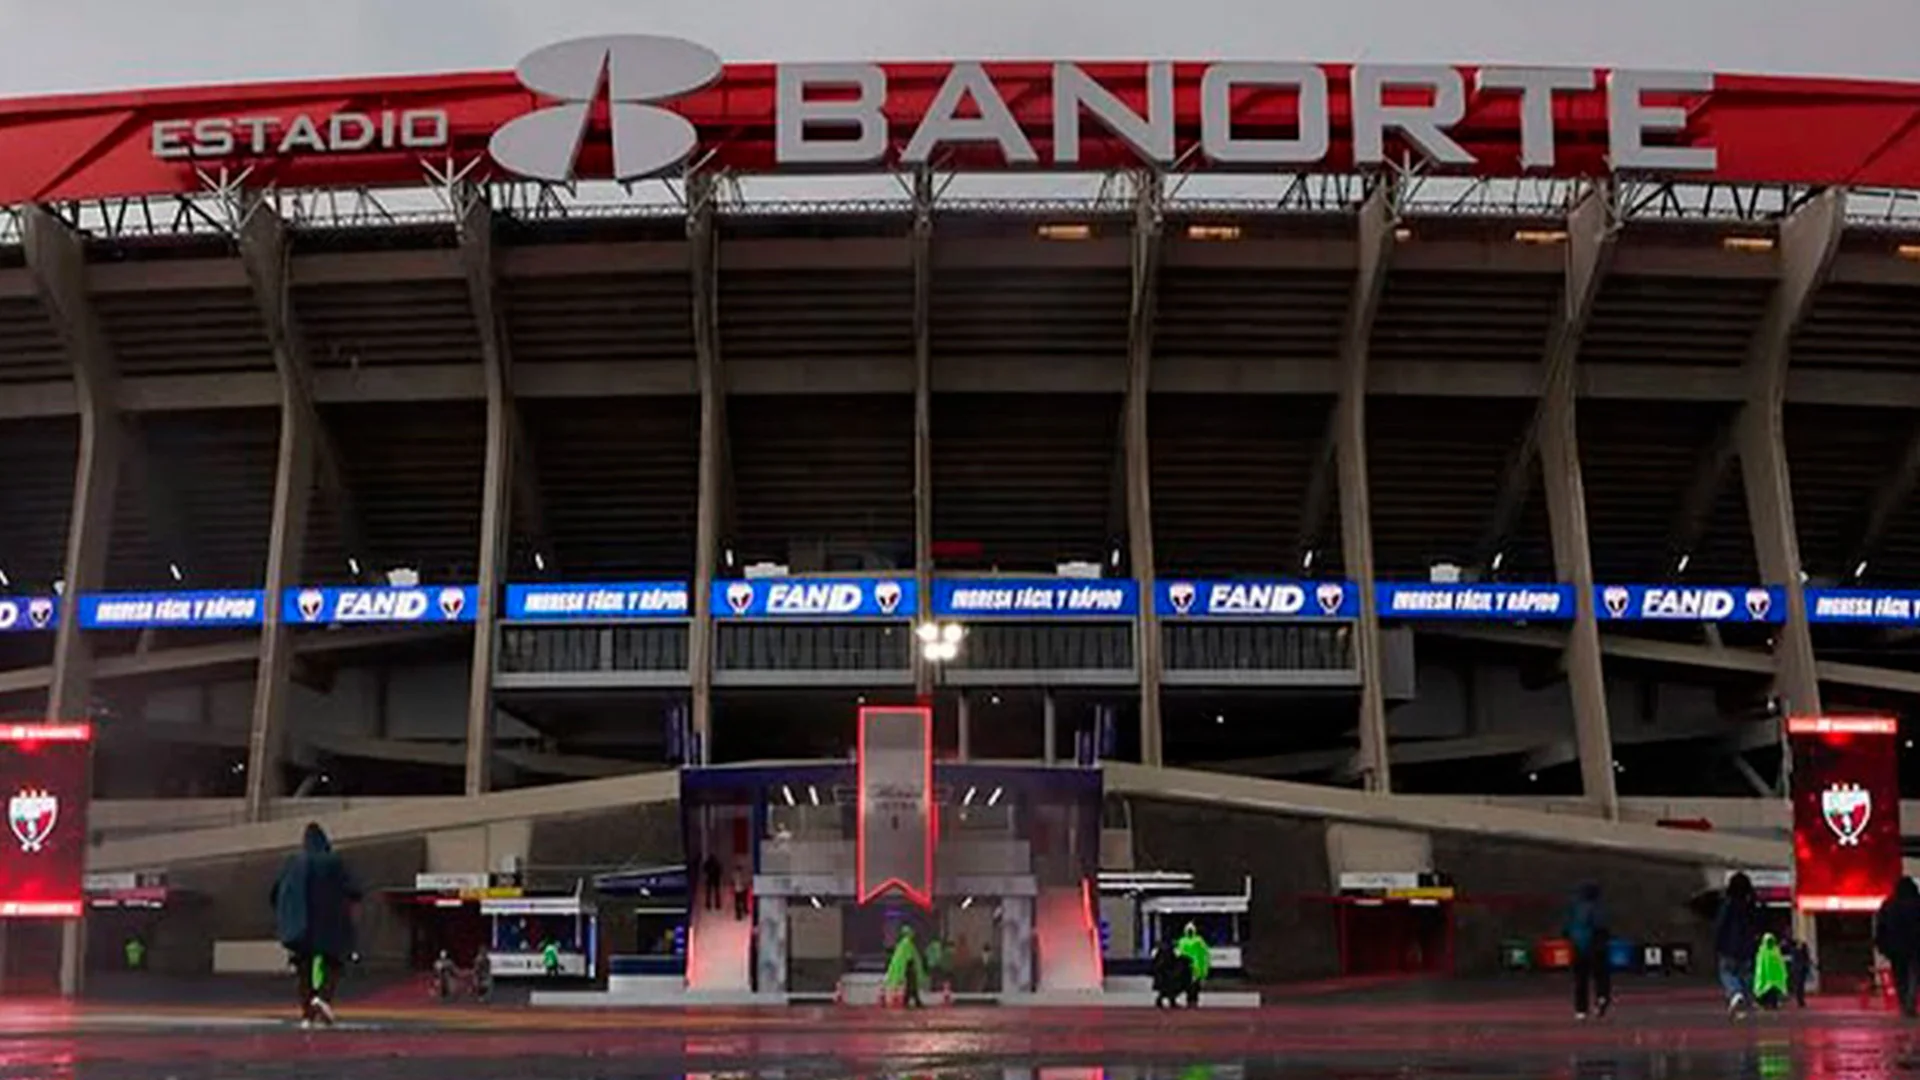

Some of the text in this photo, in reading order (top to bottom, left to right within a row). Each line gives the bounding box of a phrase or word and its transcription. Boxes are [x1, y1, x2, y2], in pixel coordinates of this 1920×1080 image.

[152, 61, 1718, 171] ESTADIO BANORTE
[628, 592, 639, 611] Y
[1057, 589, 1068, 609] Y
[1496, 591, 1507, 611] Y
[194, 600, 205, 619] Y
